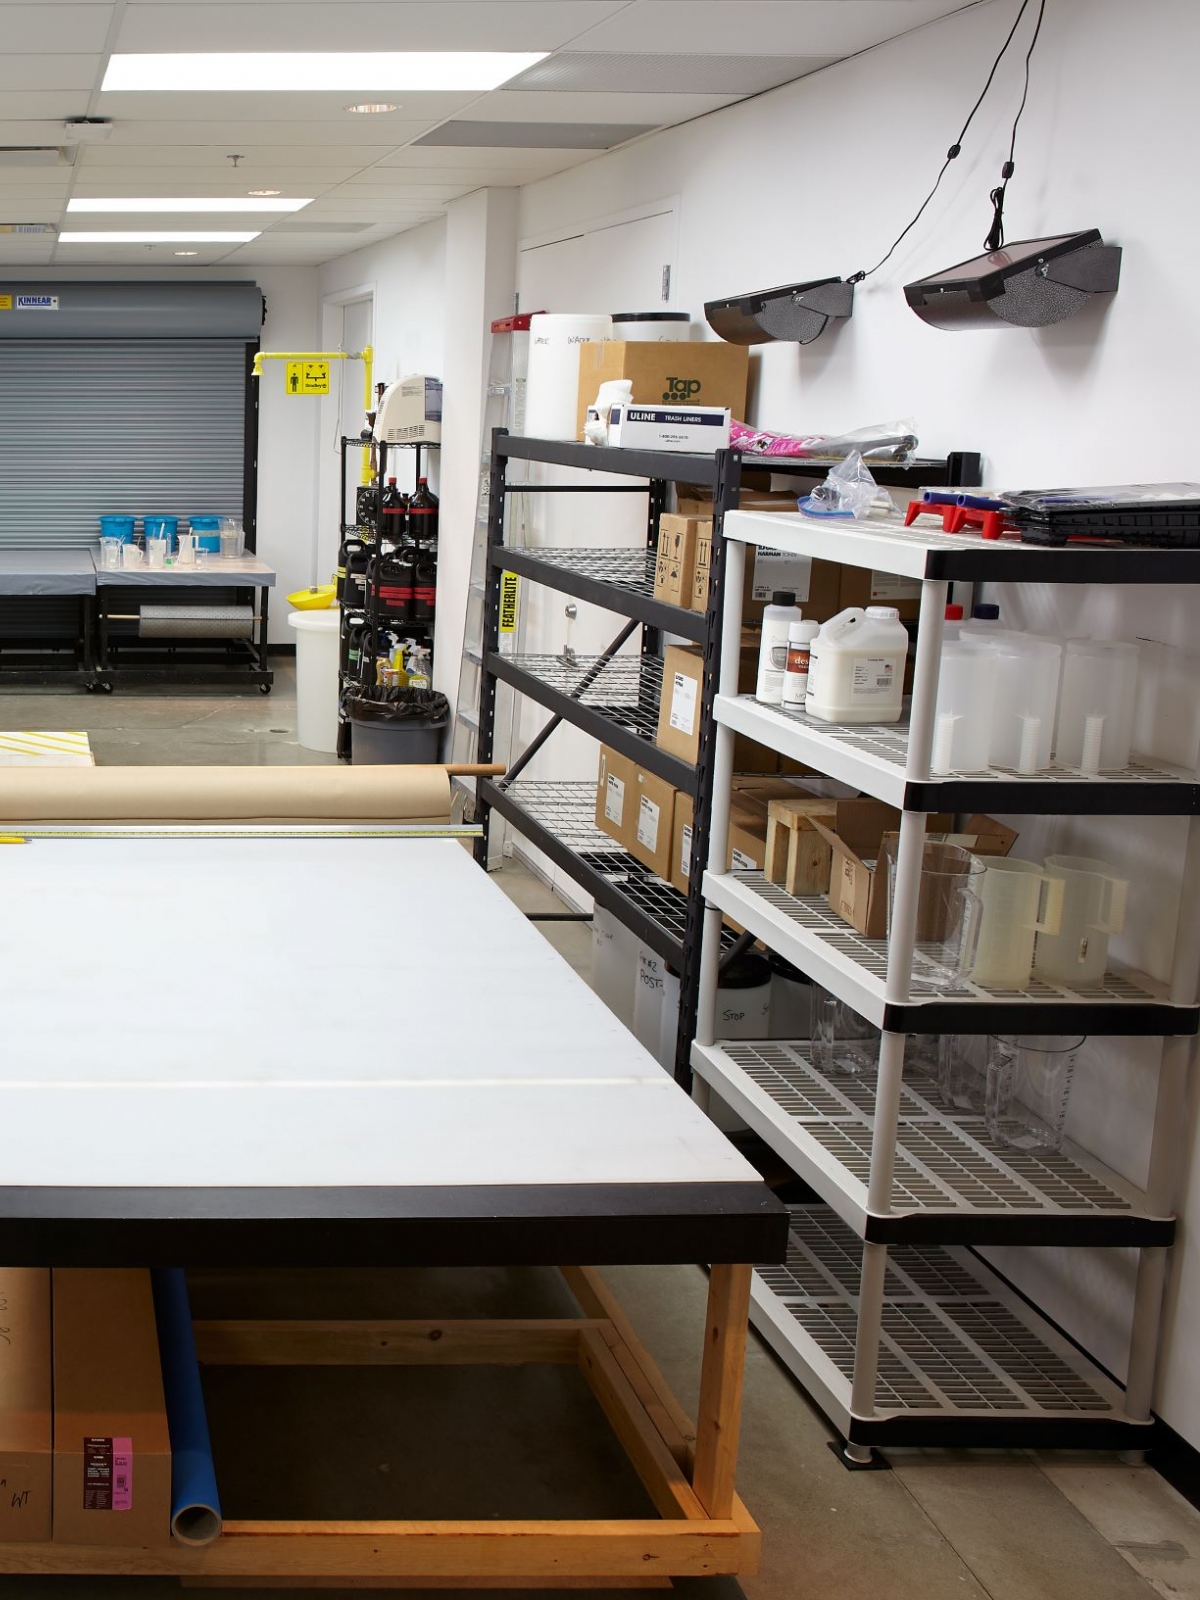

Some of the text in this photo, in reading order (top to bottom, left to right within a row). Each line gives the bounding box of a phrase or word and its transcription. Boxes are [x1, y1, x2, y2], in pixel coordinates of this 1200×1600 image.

[18, 296, 52, 307] KINNEAR
[665, 376, 702, 399] Tap
[630, 411, 656, 421] ULINE
[665, 414, 682, 422] TRASH
[501, 577, 517, 628] FEATHERLITE
[794, 656, 809, 665] des
[722, 1008, 746, 1022] STOP
